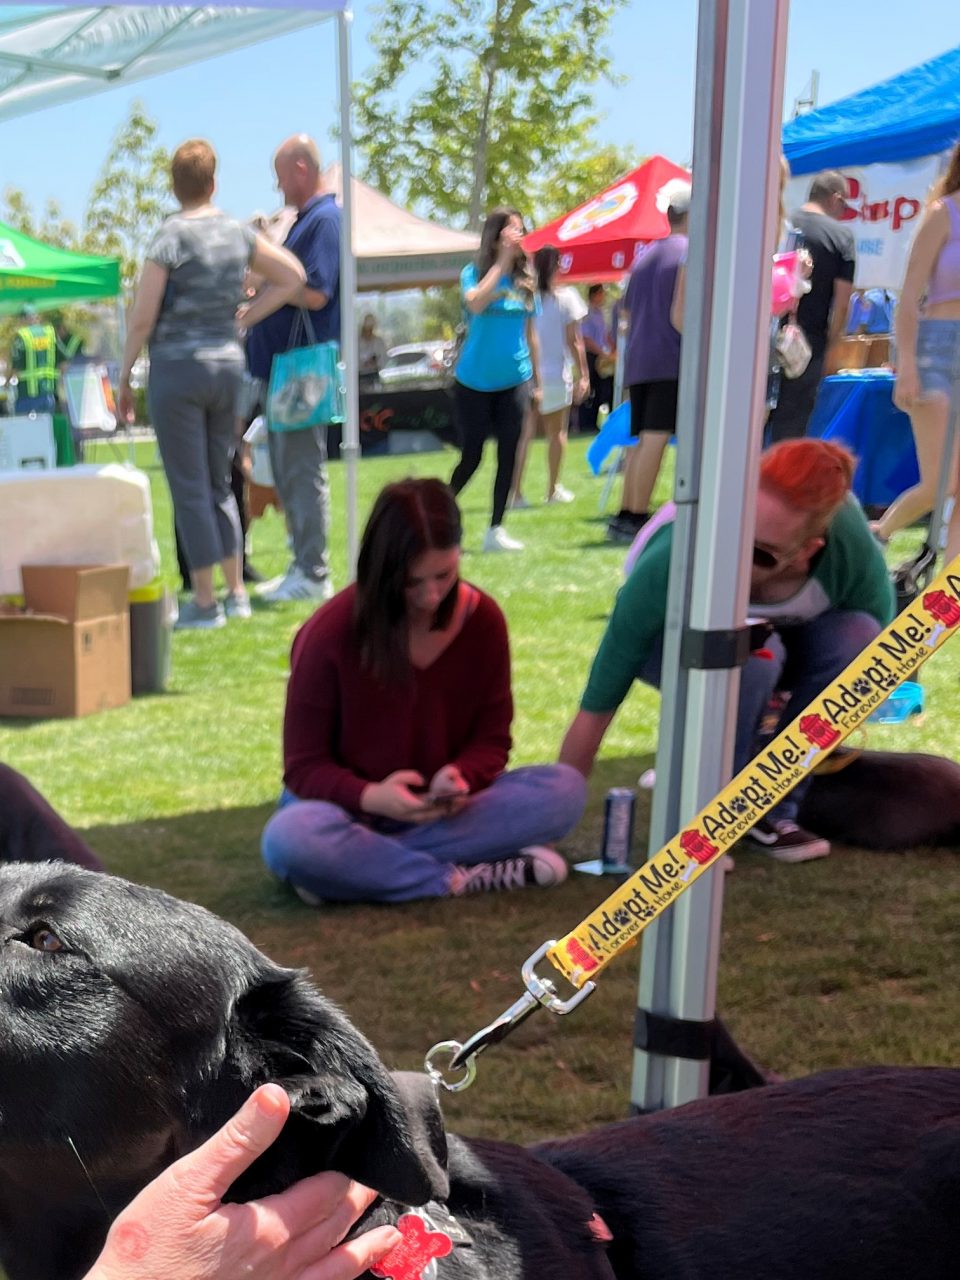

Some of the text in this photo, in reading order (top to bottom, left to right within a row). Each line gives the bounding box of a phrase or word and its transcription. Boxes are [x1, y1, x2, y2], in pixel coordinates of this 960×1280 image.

[878, 613, 932, 661] Me!
[841, 690, 882, 729] Forever
[756, 735, 806, 781] Me!
[718, 808, 758, 845] Forever
[639, 849, 685, 894] Me!
